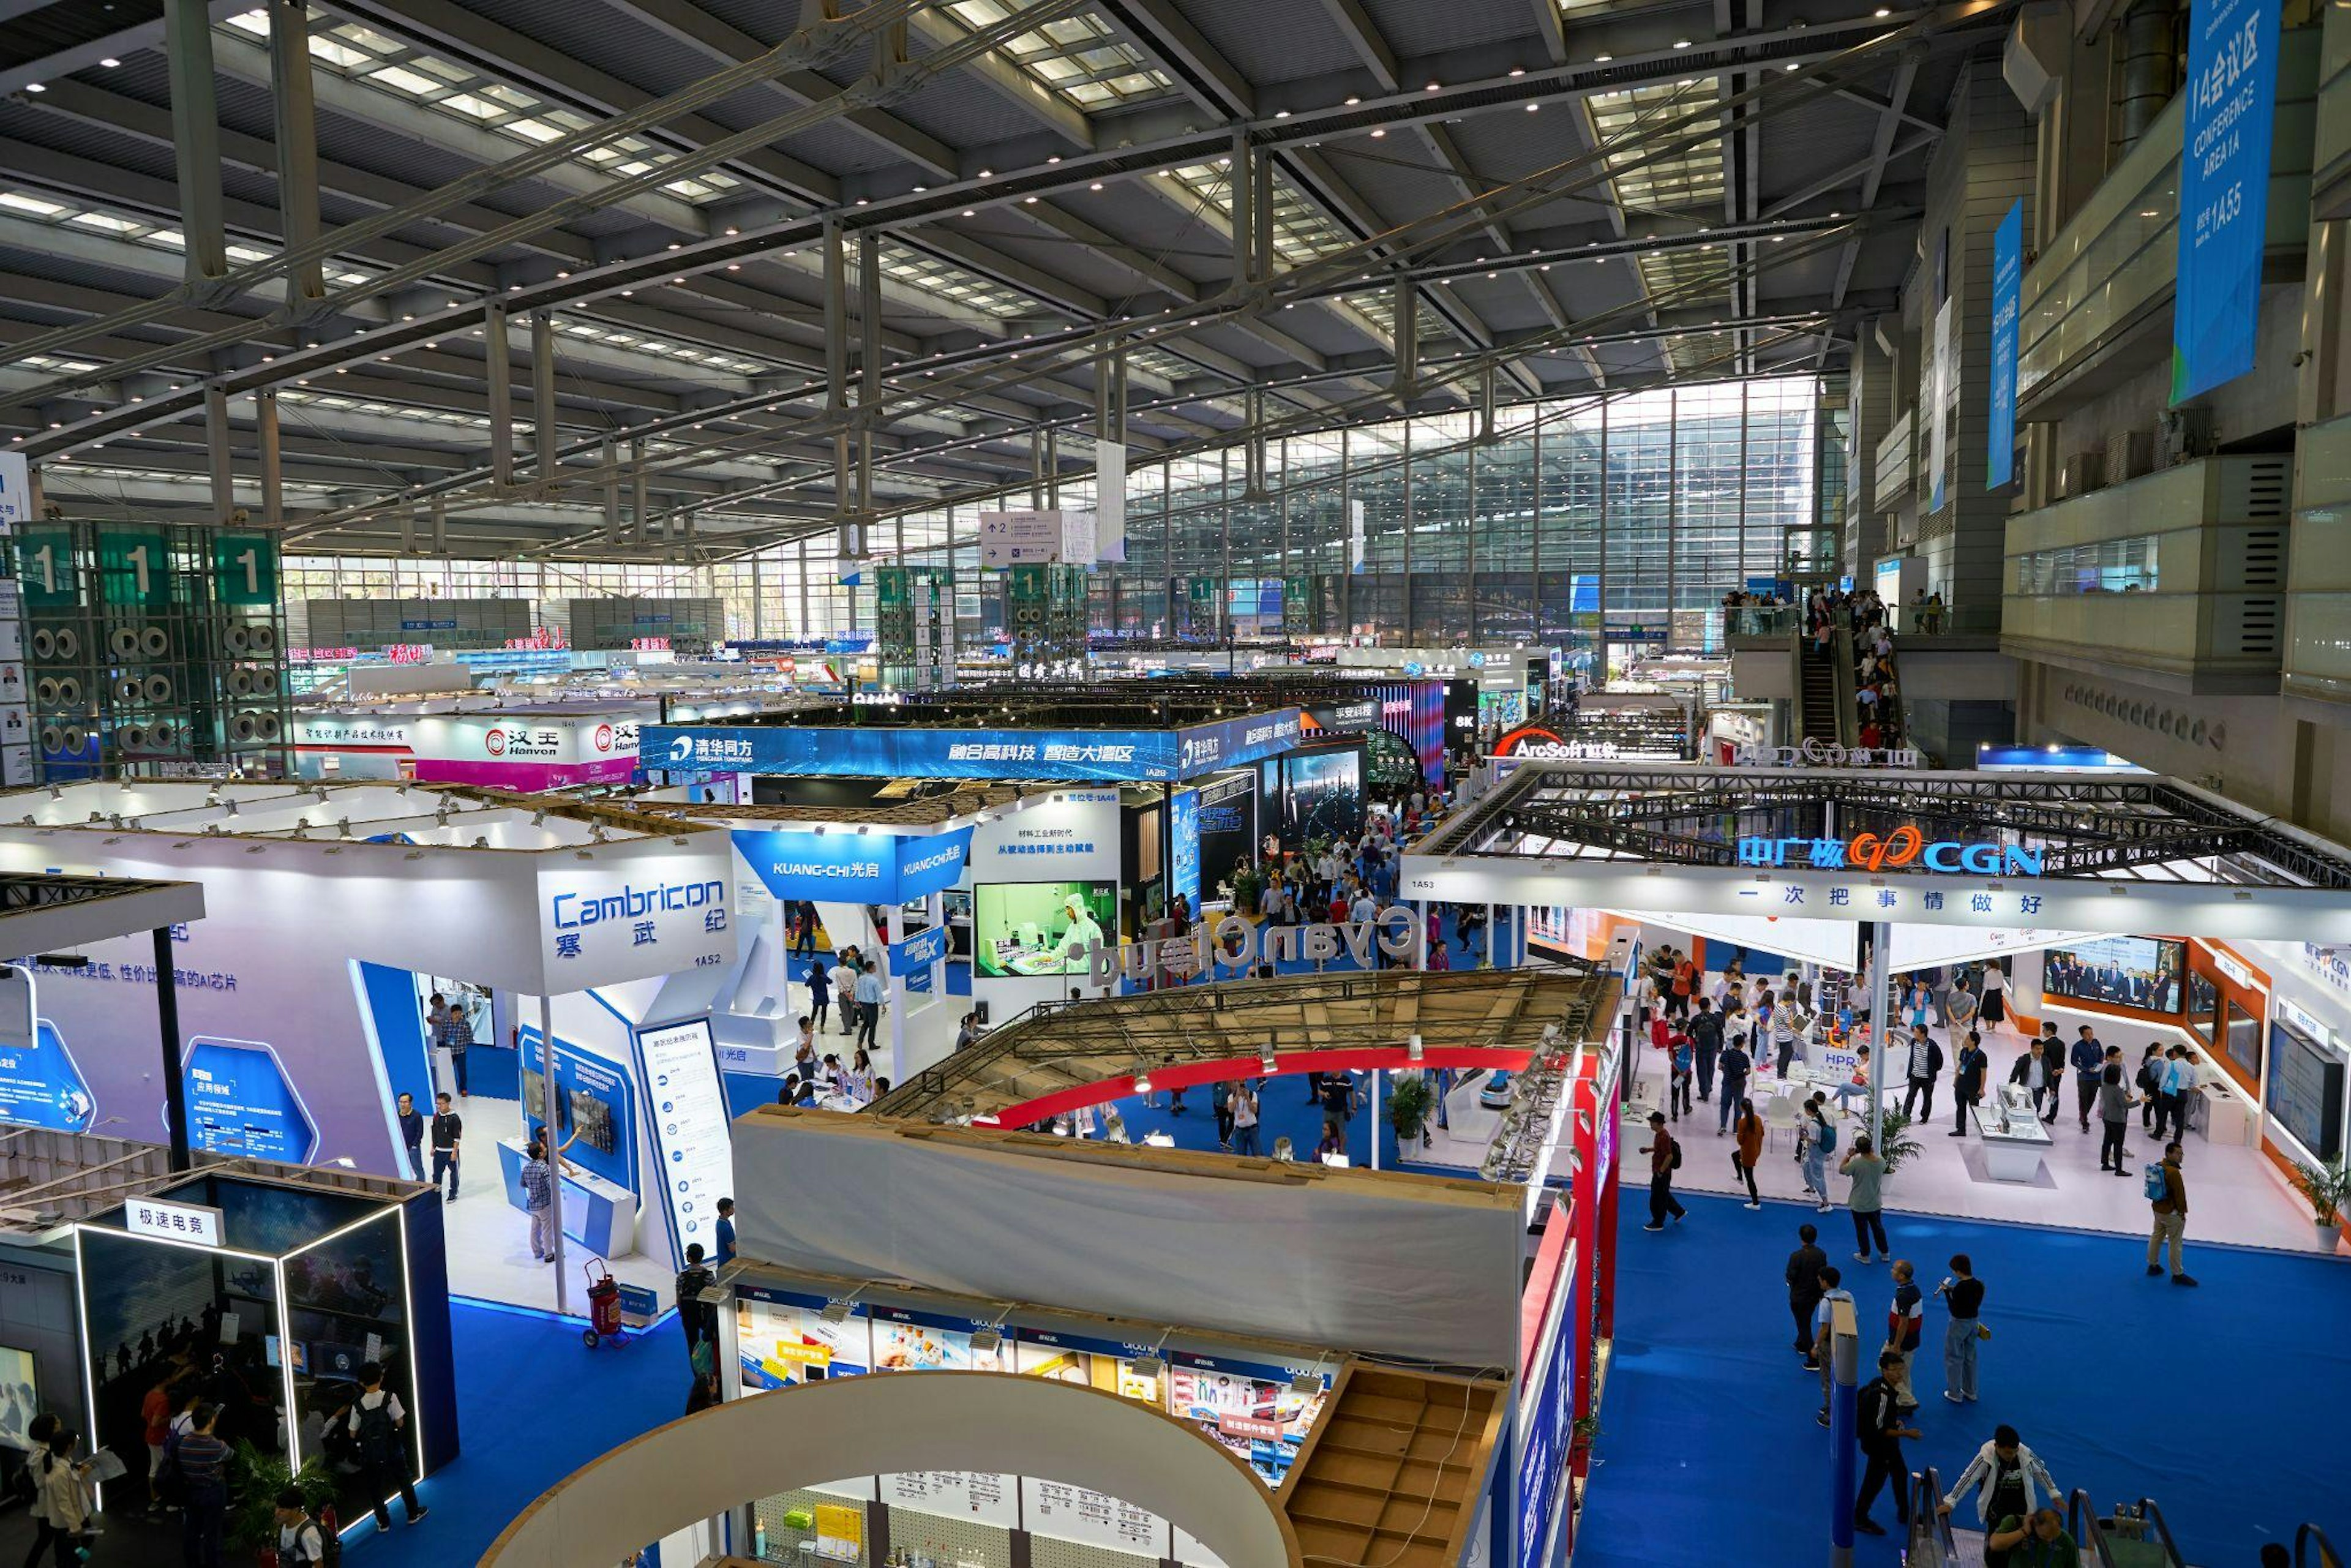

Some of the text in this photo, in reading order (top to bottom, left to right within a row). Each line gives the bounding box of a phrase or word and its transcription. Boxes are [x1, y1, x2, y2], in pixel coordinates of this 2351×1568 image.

[2194, 80, 2254, 158] CONFERENCE
[2203, 141, 2227, 181] AREA
[2212, 181, 2241, 233] 1A55
[1000, 523, 1006, 533] 2
[35, 545, 56, 593] 1
[127, 546, 149, 593] 1
[237, 549, 257, 592] 1
[887, 576, 896, 596] 1
[1023, 573, 1034, 595] 1
[1078, 573, 1085, 593] 1
[1197, 583, 1205, 596] 1
[1292, 582, 1300, 595] 1
[1455, 715, 1474, 727] 8K
[509, 730, 558, 747] 汉王
[695, 738, 752, 756] 清华同方
[1194, 736, 1219, 759] 清华同方
[509, 747, 557, 756] Hanvon
[948, 744, 1134, 762] 融合高科技 智造大湾区
[1018, 829, 1073, 838] 材料工业新时代
[998, 844, 1094, 855] 从被动选择到主动赋能
[1738, 836, 2042, 876] 中广核 CGN
[1412, 880, 1434, 889] 1A53
[553, 880, 723, 929] Cambricon
[1739, 886, 2041, 914] 一次把事情做好
[557, 909, 727, 958] 寒武纪
[695, 954, 721, 967] 1A52
[2331, 958, 2349, 979] CGN
[726, 1049, 746, 1062] 光启
[140, 1208, 203, 1234] 极速电竞
